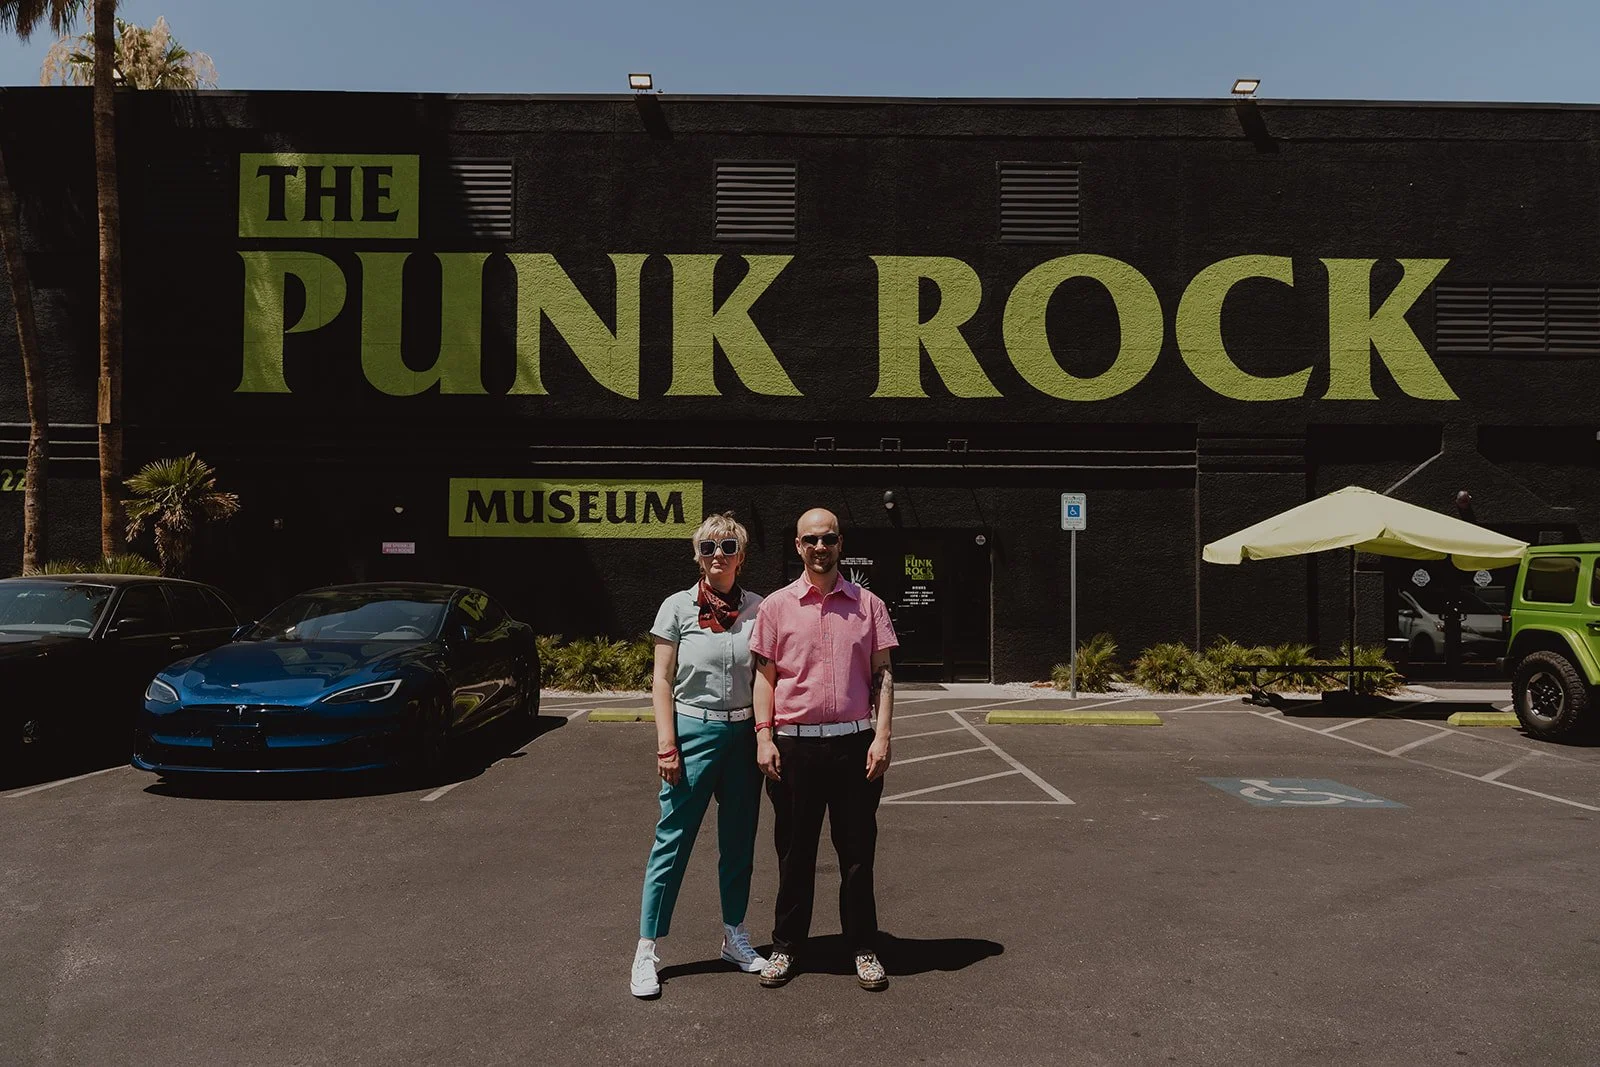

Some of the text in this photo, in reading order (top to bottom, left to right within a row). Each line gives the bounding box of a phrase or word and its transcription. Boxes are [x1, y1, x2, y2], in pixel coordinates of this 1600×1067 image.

[256, 166, 399, 222] THE
[234, 251, 1460, 402] PUNK ROCK
[464, 490, 685, 525] MUSEUM
[905, 559, 933, 567] PUNK
[905, 567, 934, 576] ROCK
